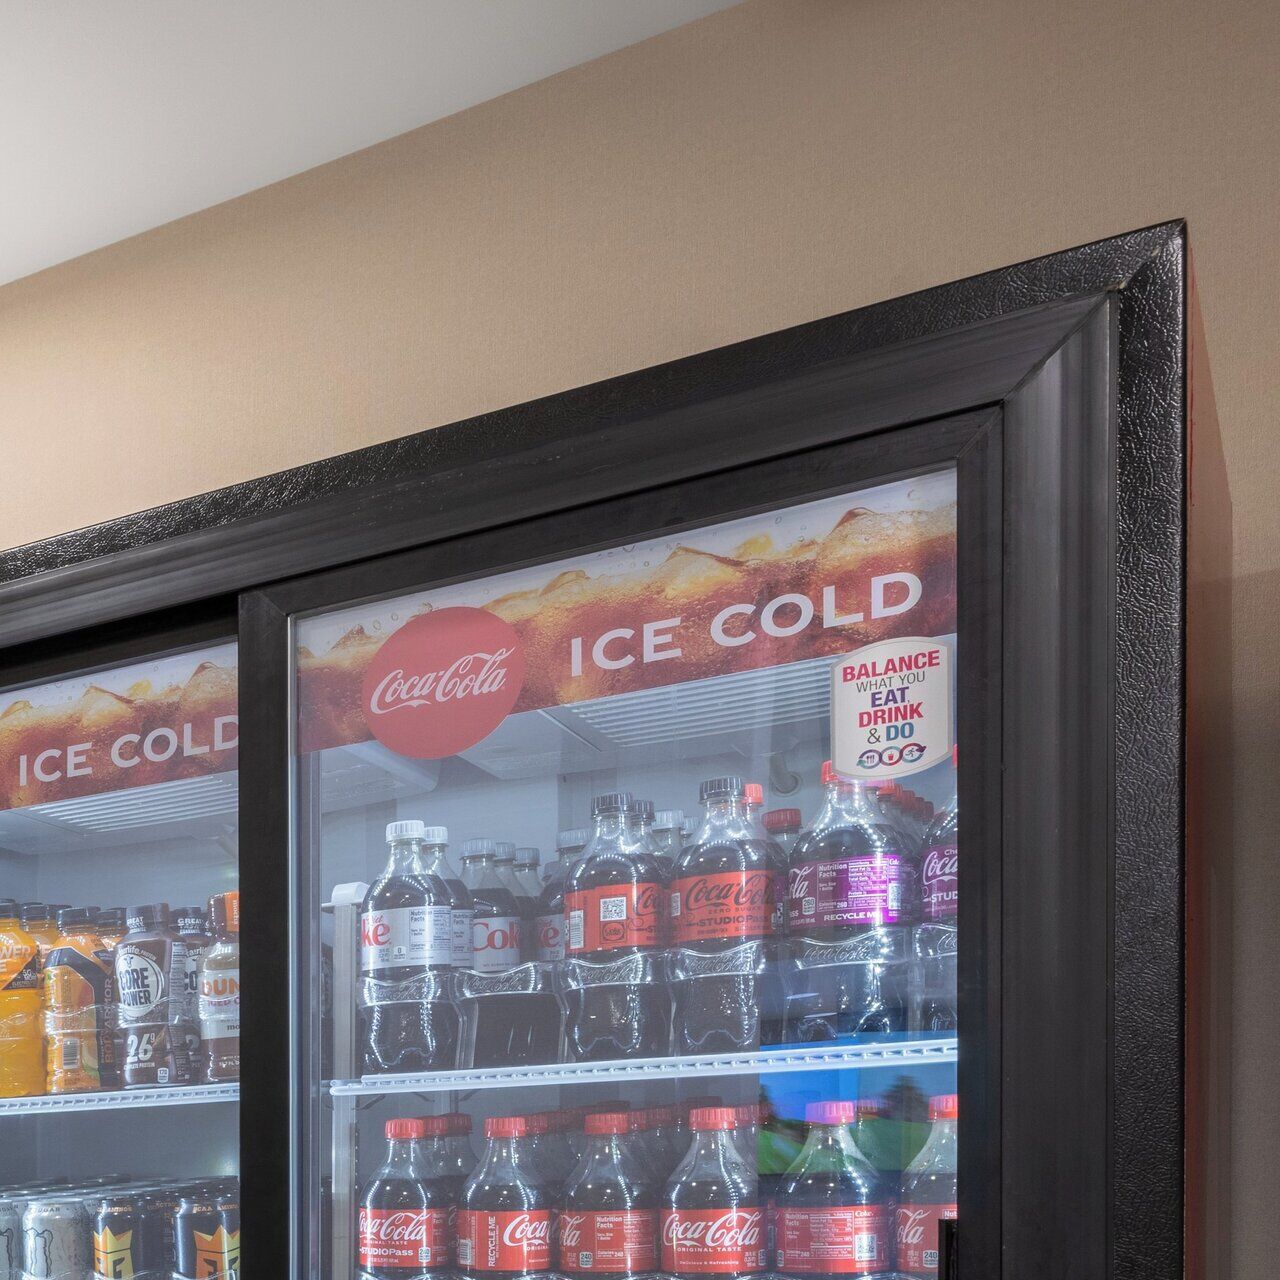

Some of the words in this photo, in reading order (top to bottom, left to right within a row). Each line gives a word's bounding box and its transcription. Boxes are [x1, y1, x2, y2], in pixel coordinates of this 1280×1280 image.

[370, 646, 516, 714] Coca-Cola
[571, 618, 682, 677] ICE
[710, 571, 923, 648] COLD
[842, 650, 940, 683] BALANCE
[856, 676, 894, 693] WHAT
[899, 670, 925, 685] YOU
[859, 702, 924, 728] DRINK
[867, 728, 880, 744] &
[886, 722, 914, 741] DO
[19, 742, 92, 786] ICE
[111, 714, 238, 768] COLD
[824, 912, 865, 921] RECYCLE
[119, 968, 150, 990] CORE
[122, 990, 151, 1006] POWER
[488, 1216, 496, 1228] ME
[663, 1212, 762, 1246] Coca-Cola
[924, 1251, 937, 1260] 240
